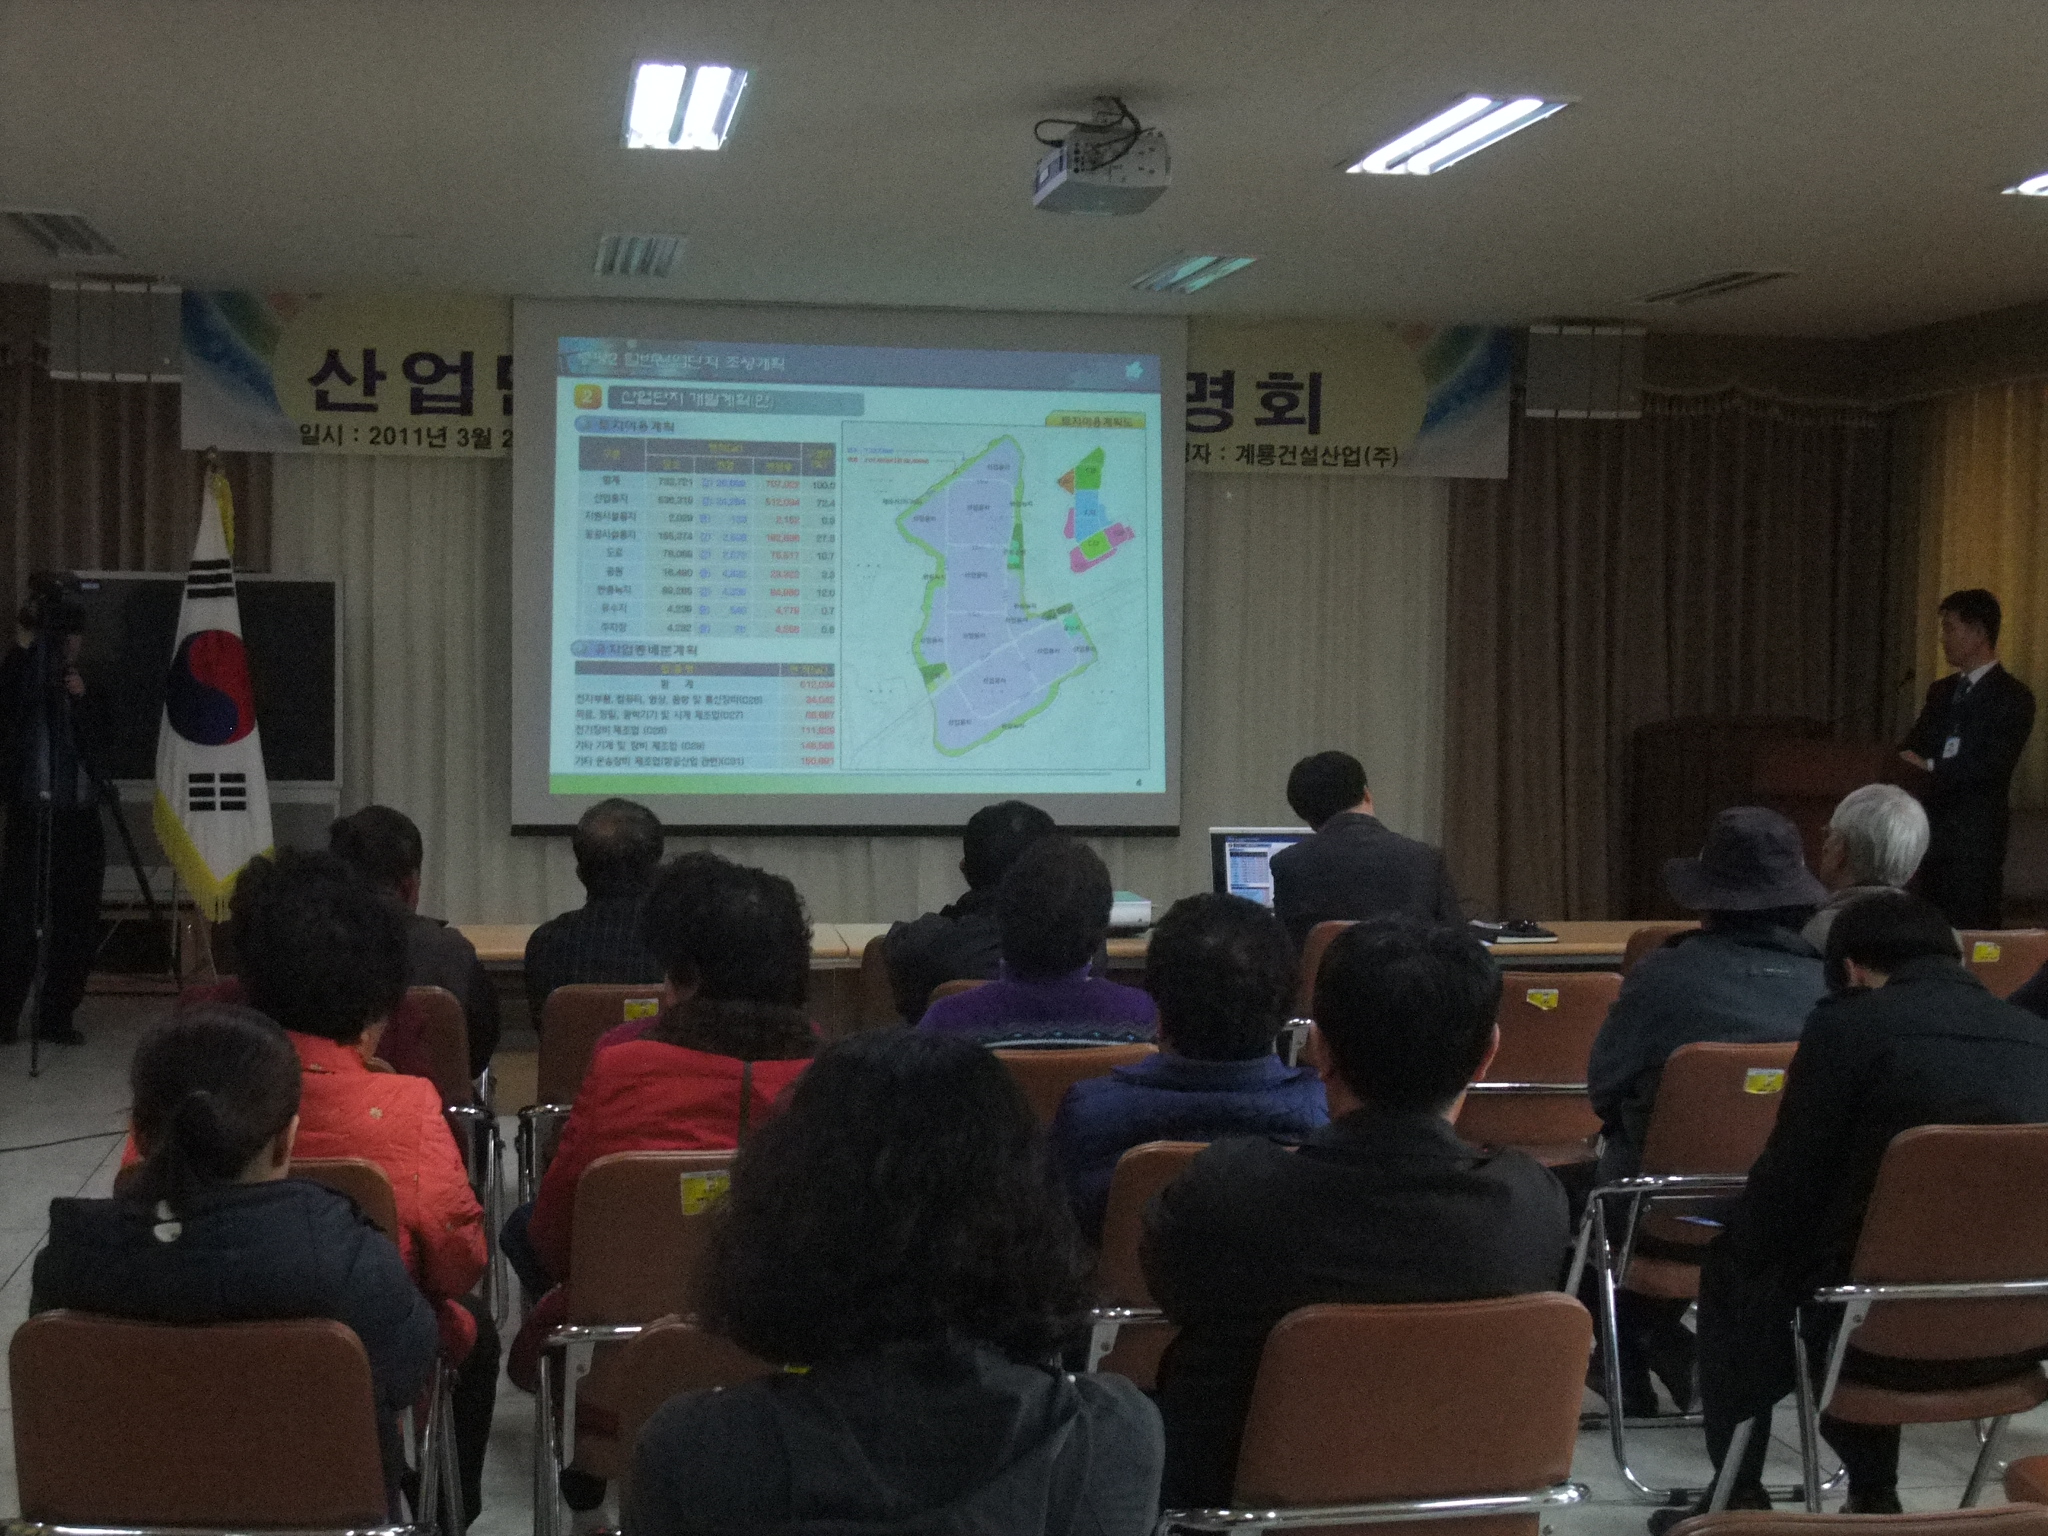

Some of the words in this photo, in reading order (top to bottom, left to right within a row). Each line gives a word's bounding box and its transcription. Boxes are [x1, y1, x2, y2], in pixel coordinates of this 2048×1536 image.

[307, 347, 513, 416] 산업
[581, 389, 593, 404] 2
[621, 390, 685, 406] 산업단지
[690, 392, 775, 409] 개발계획(안)
[300, 424, 343, 447] 일시
[369, 426, 447, 449] 2011년
[457, 427, 492, 449] 3월
[1235, 443, 1400, 469] 계룡건설산업(주)
